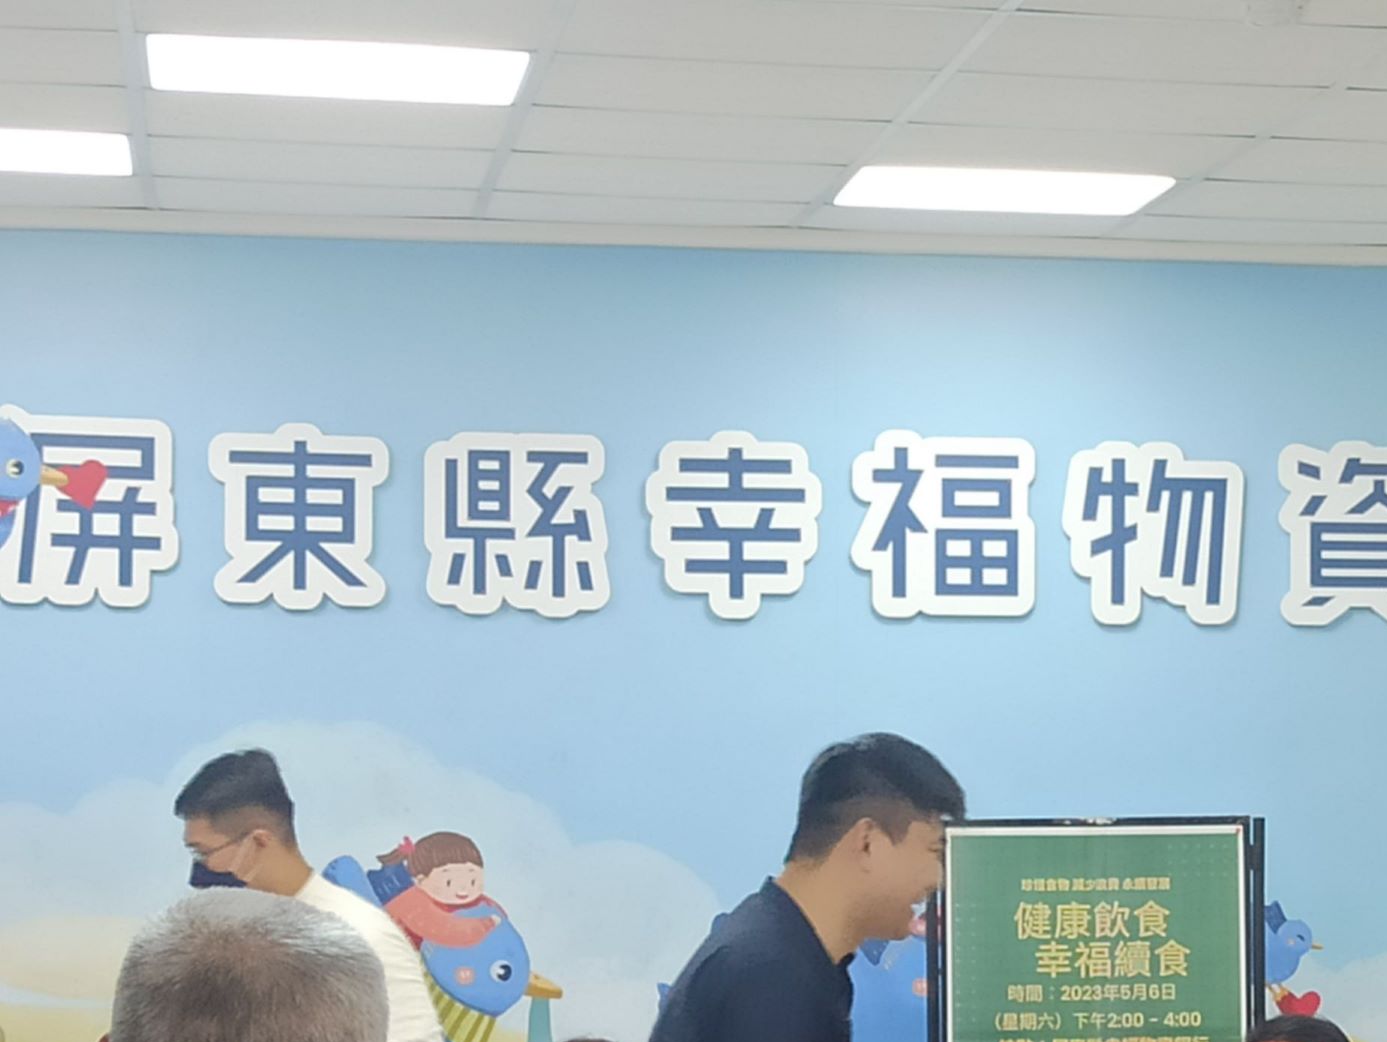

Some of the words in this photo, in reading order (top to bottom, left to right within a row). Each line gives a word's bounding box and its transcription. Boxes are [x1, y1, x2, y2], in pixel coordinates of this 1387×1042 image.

[1014, 900, 1170, 940] 健康飲食
[1035, 939, 1191, 979] 幸福續食
